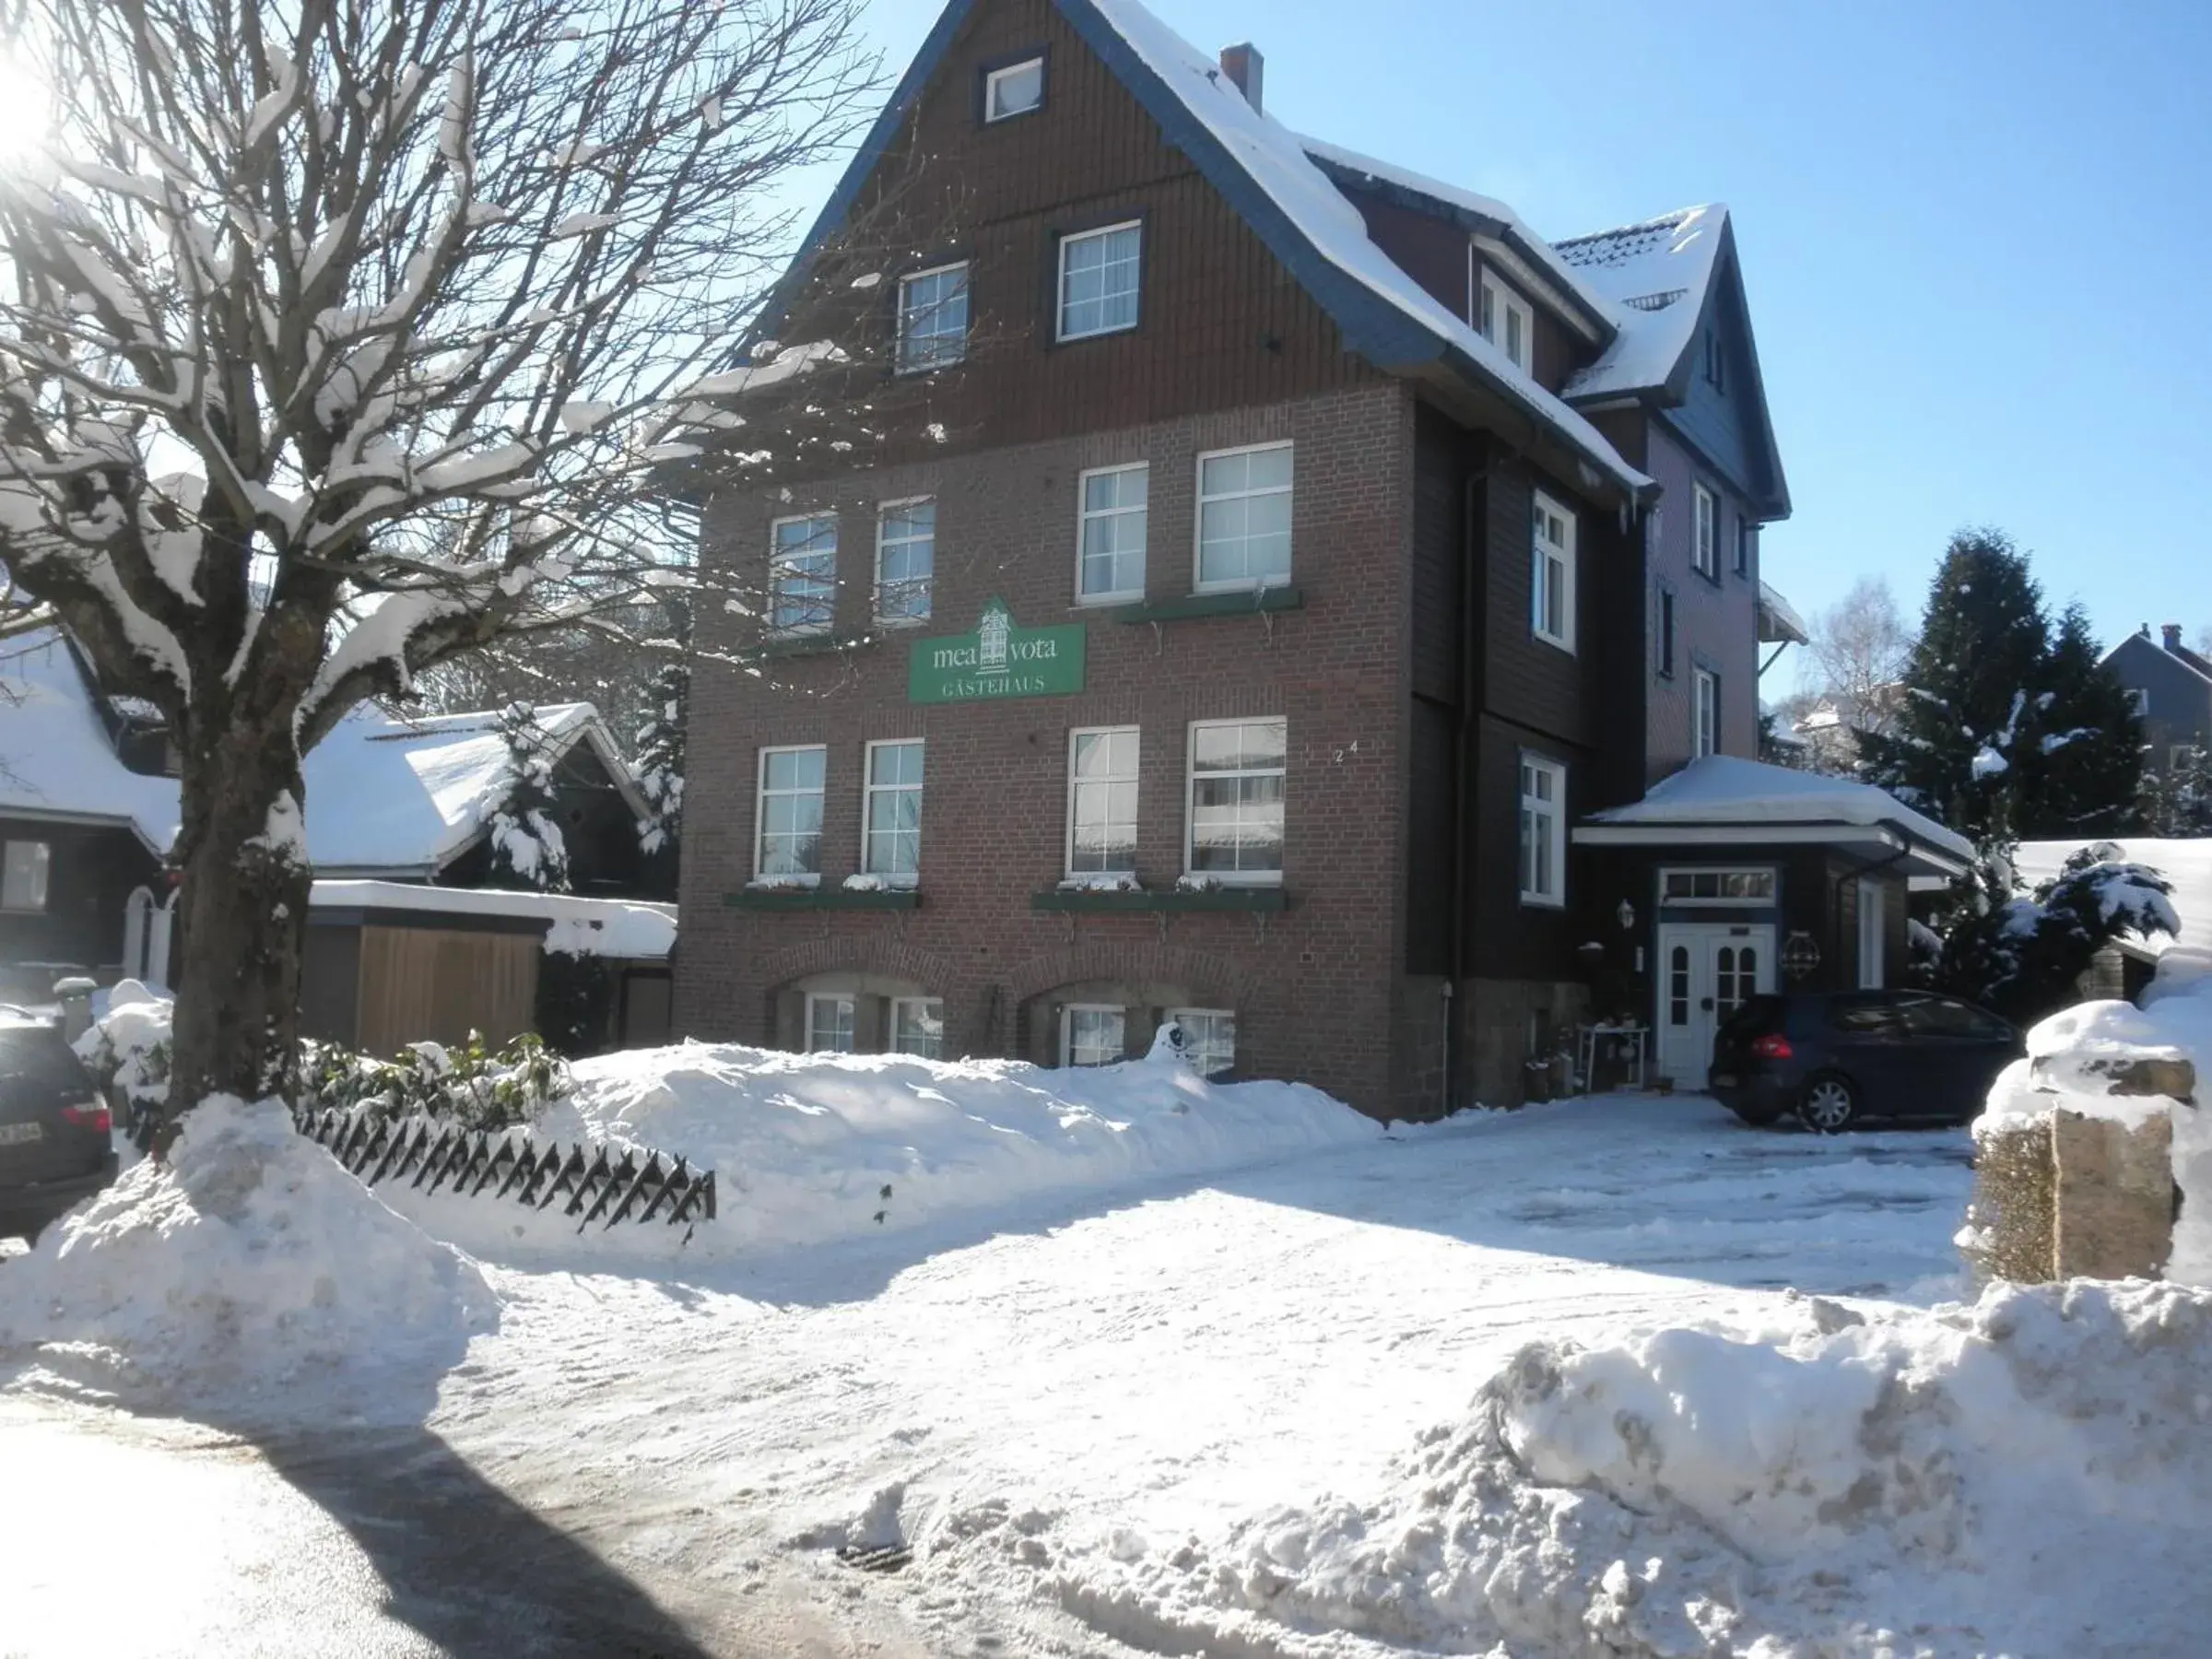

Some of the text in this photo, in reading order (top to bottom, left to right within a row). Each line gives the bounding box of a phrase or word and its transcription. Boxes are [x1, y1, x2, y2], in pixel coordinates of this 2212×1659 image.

[933, 638, 1058, 669] mea vota
[943, 675, 1045, 698] GÄSTEHAUS
